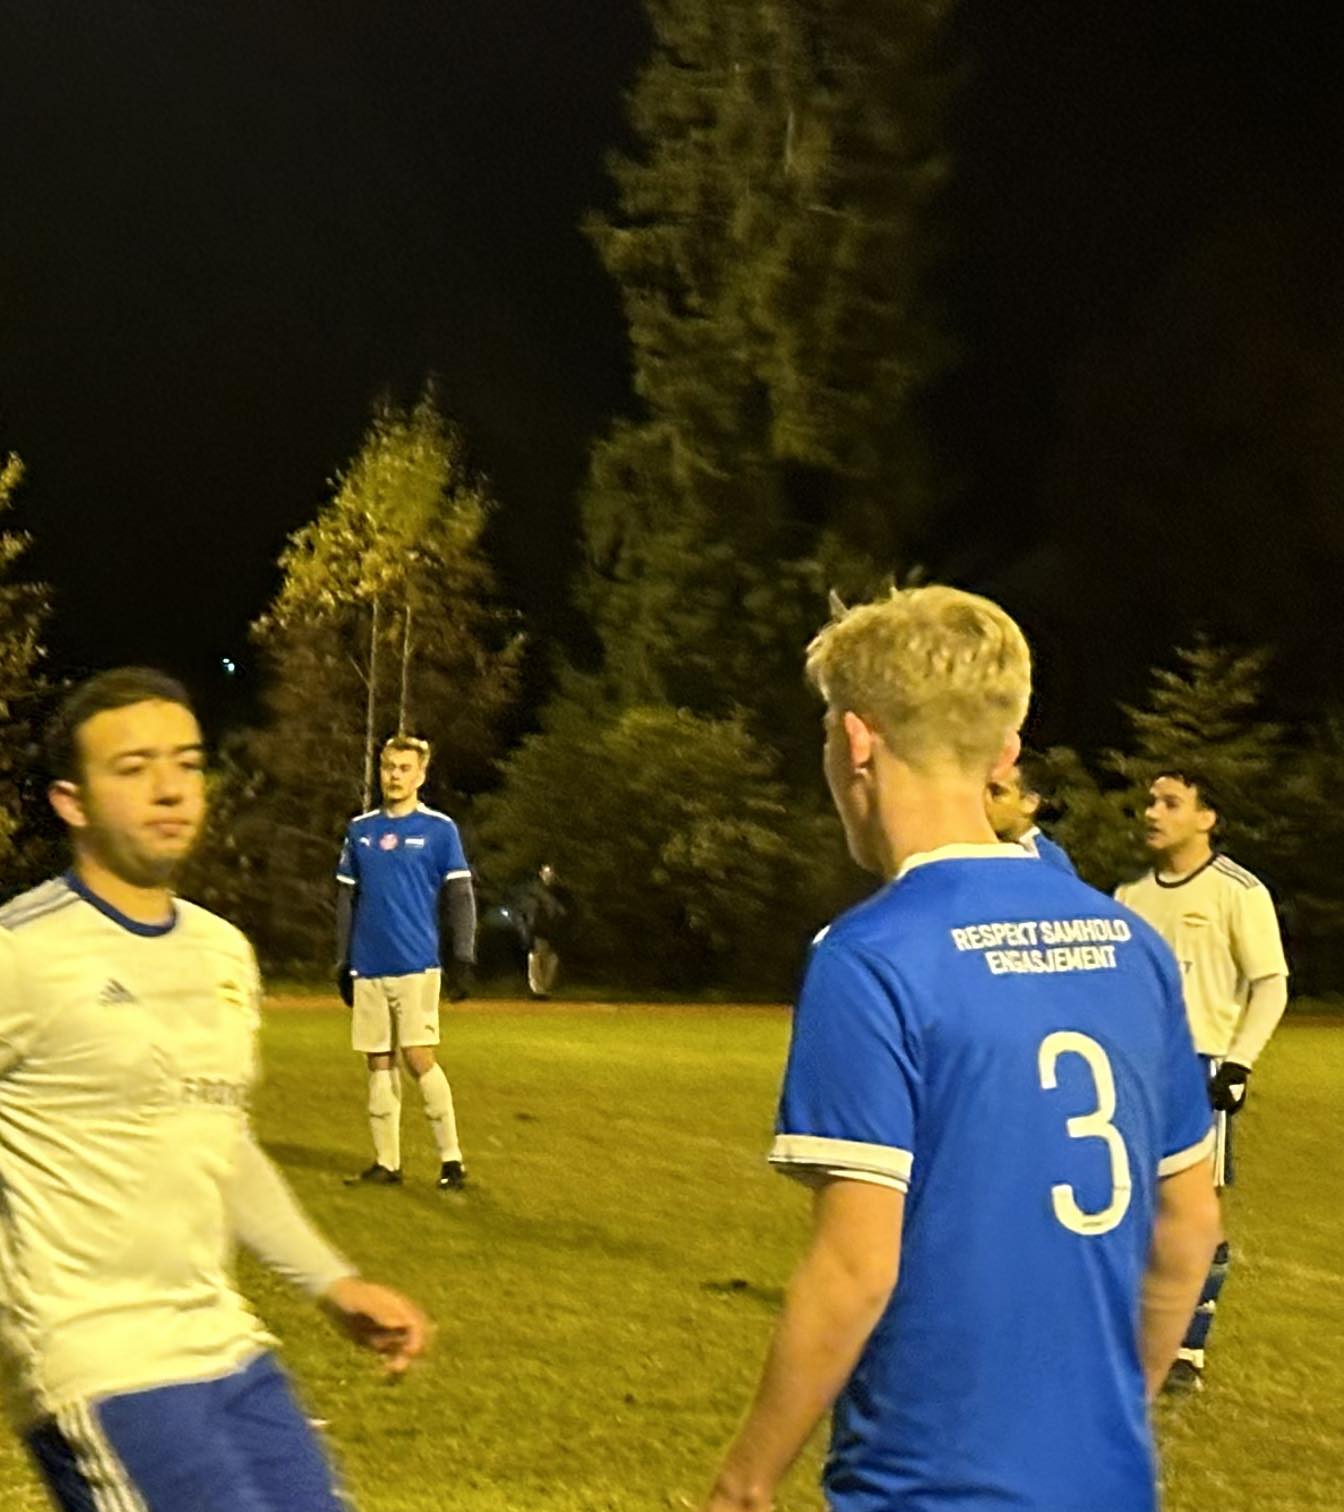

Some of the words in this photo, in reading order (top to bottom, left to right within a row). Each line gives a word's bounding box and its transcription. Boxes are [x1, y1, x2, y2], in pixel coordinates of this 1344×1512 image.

[951, 921, 1038, 951] RESPEKT
[985, 945, 1117, 976] ENGASJEMENT
[1037, 1030, 1132, 1236] 3
